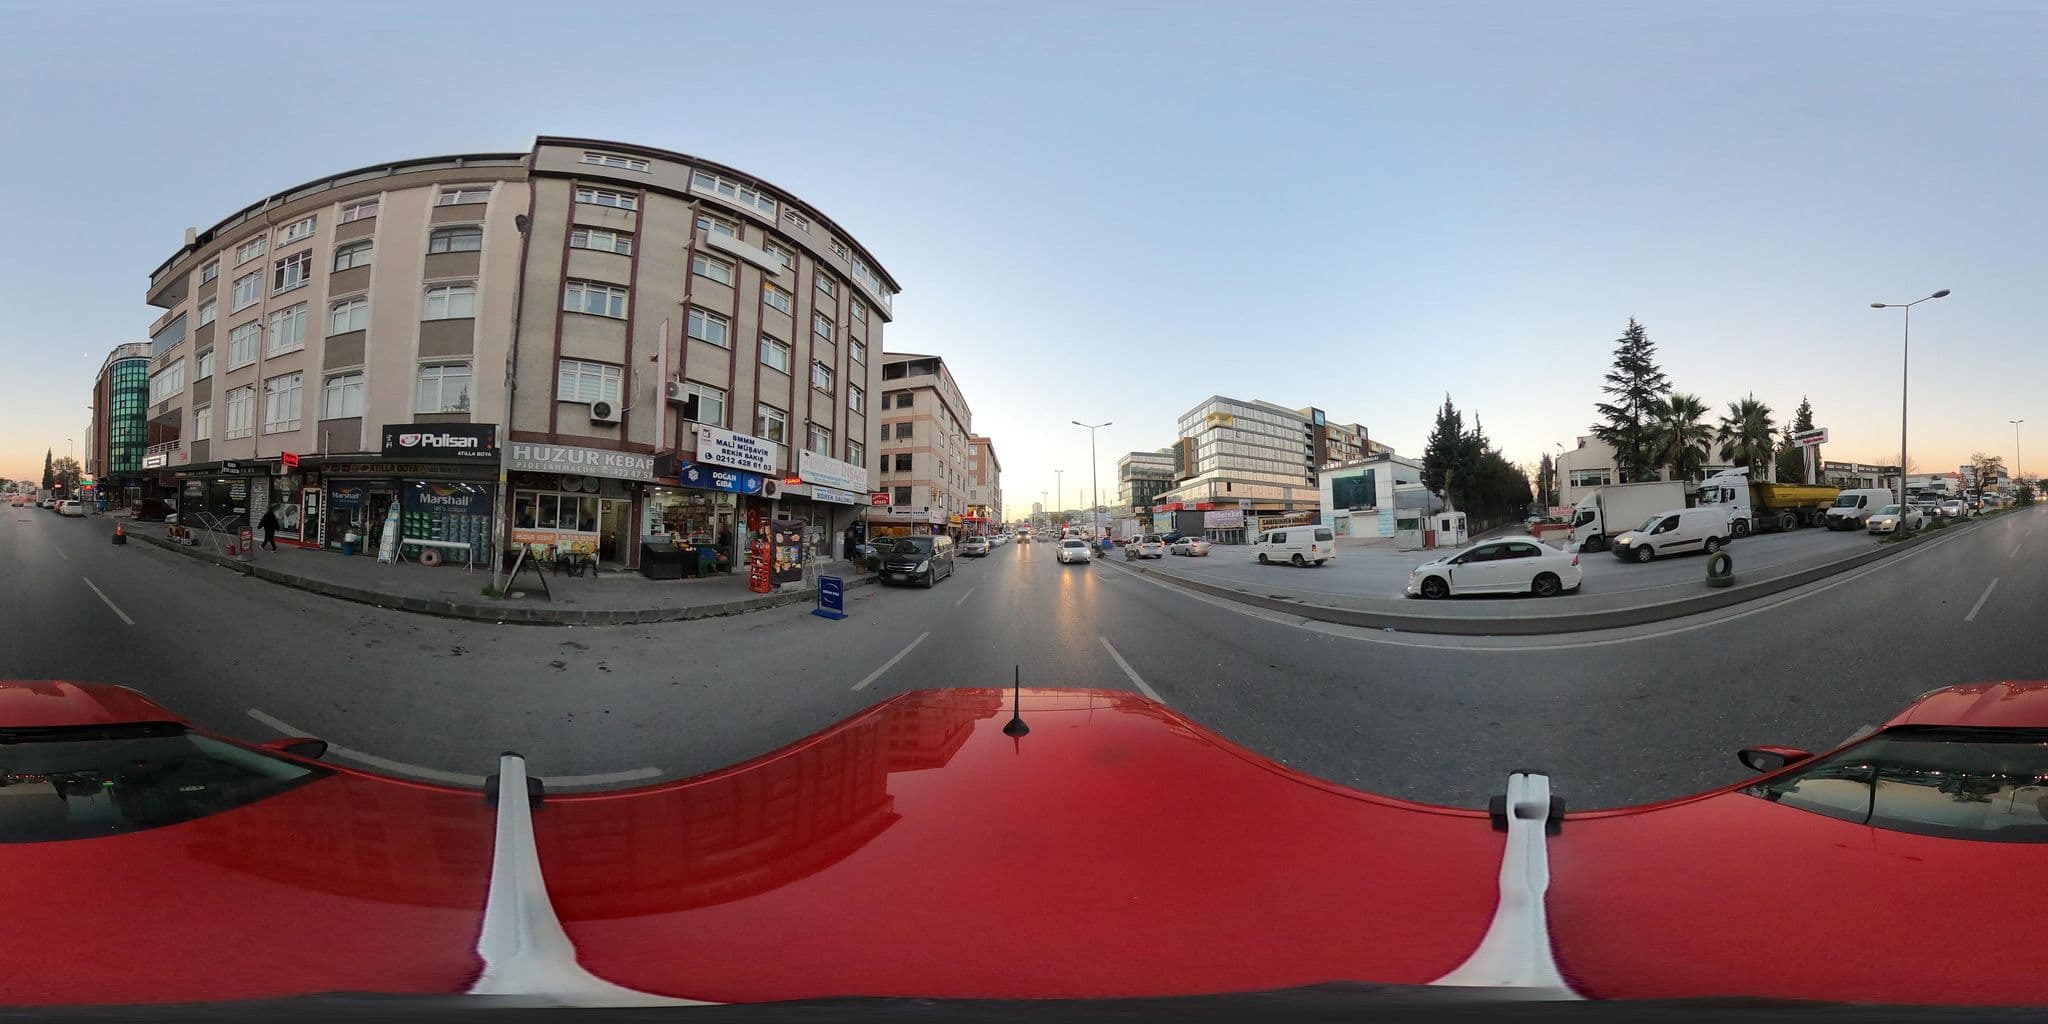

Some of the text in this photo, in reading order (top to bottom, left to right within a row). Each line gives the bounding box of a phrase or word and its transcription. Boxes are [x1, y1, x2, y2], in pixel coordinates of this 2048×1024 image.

[422, 434, 478, 448] Polisan
[716, 439, 735, 448] MALİ
[514, 445, 654, 469] HUZUR KEBAP
[716, 455, 736, 464] 0212
[543, 463, 596, 473] LAHMACUN
[712, 471, 736, 480] DOĞAN
